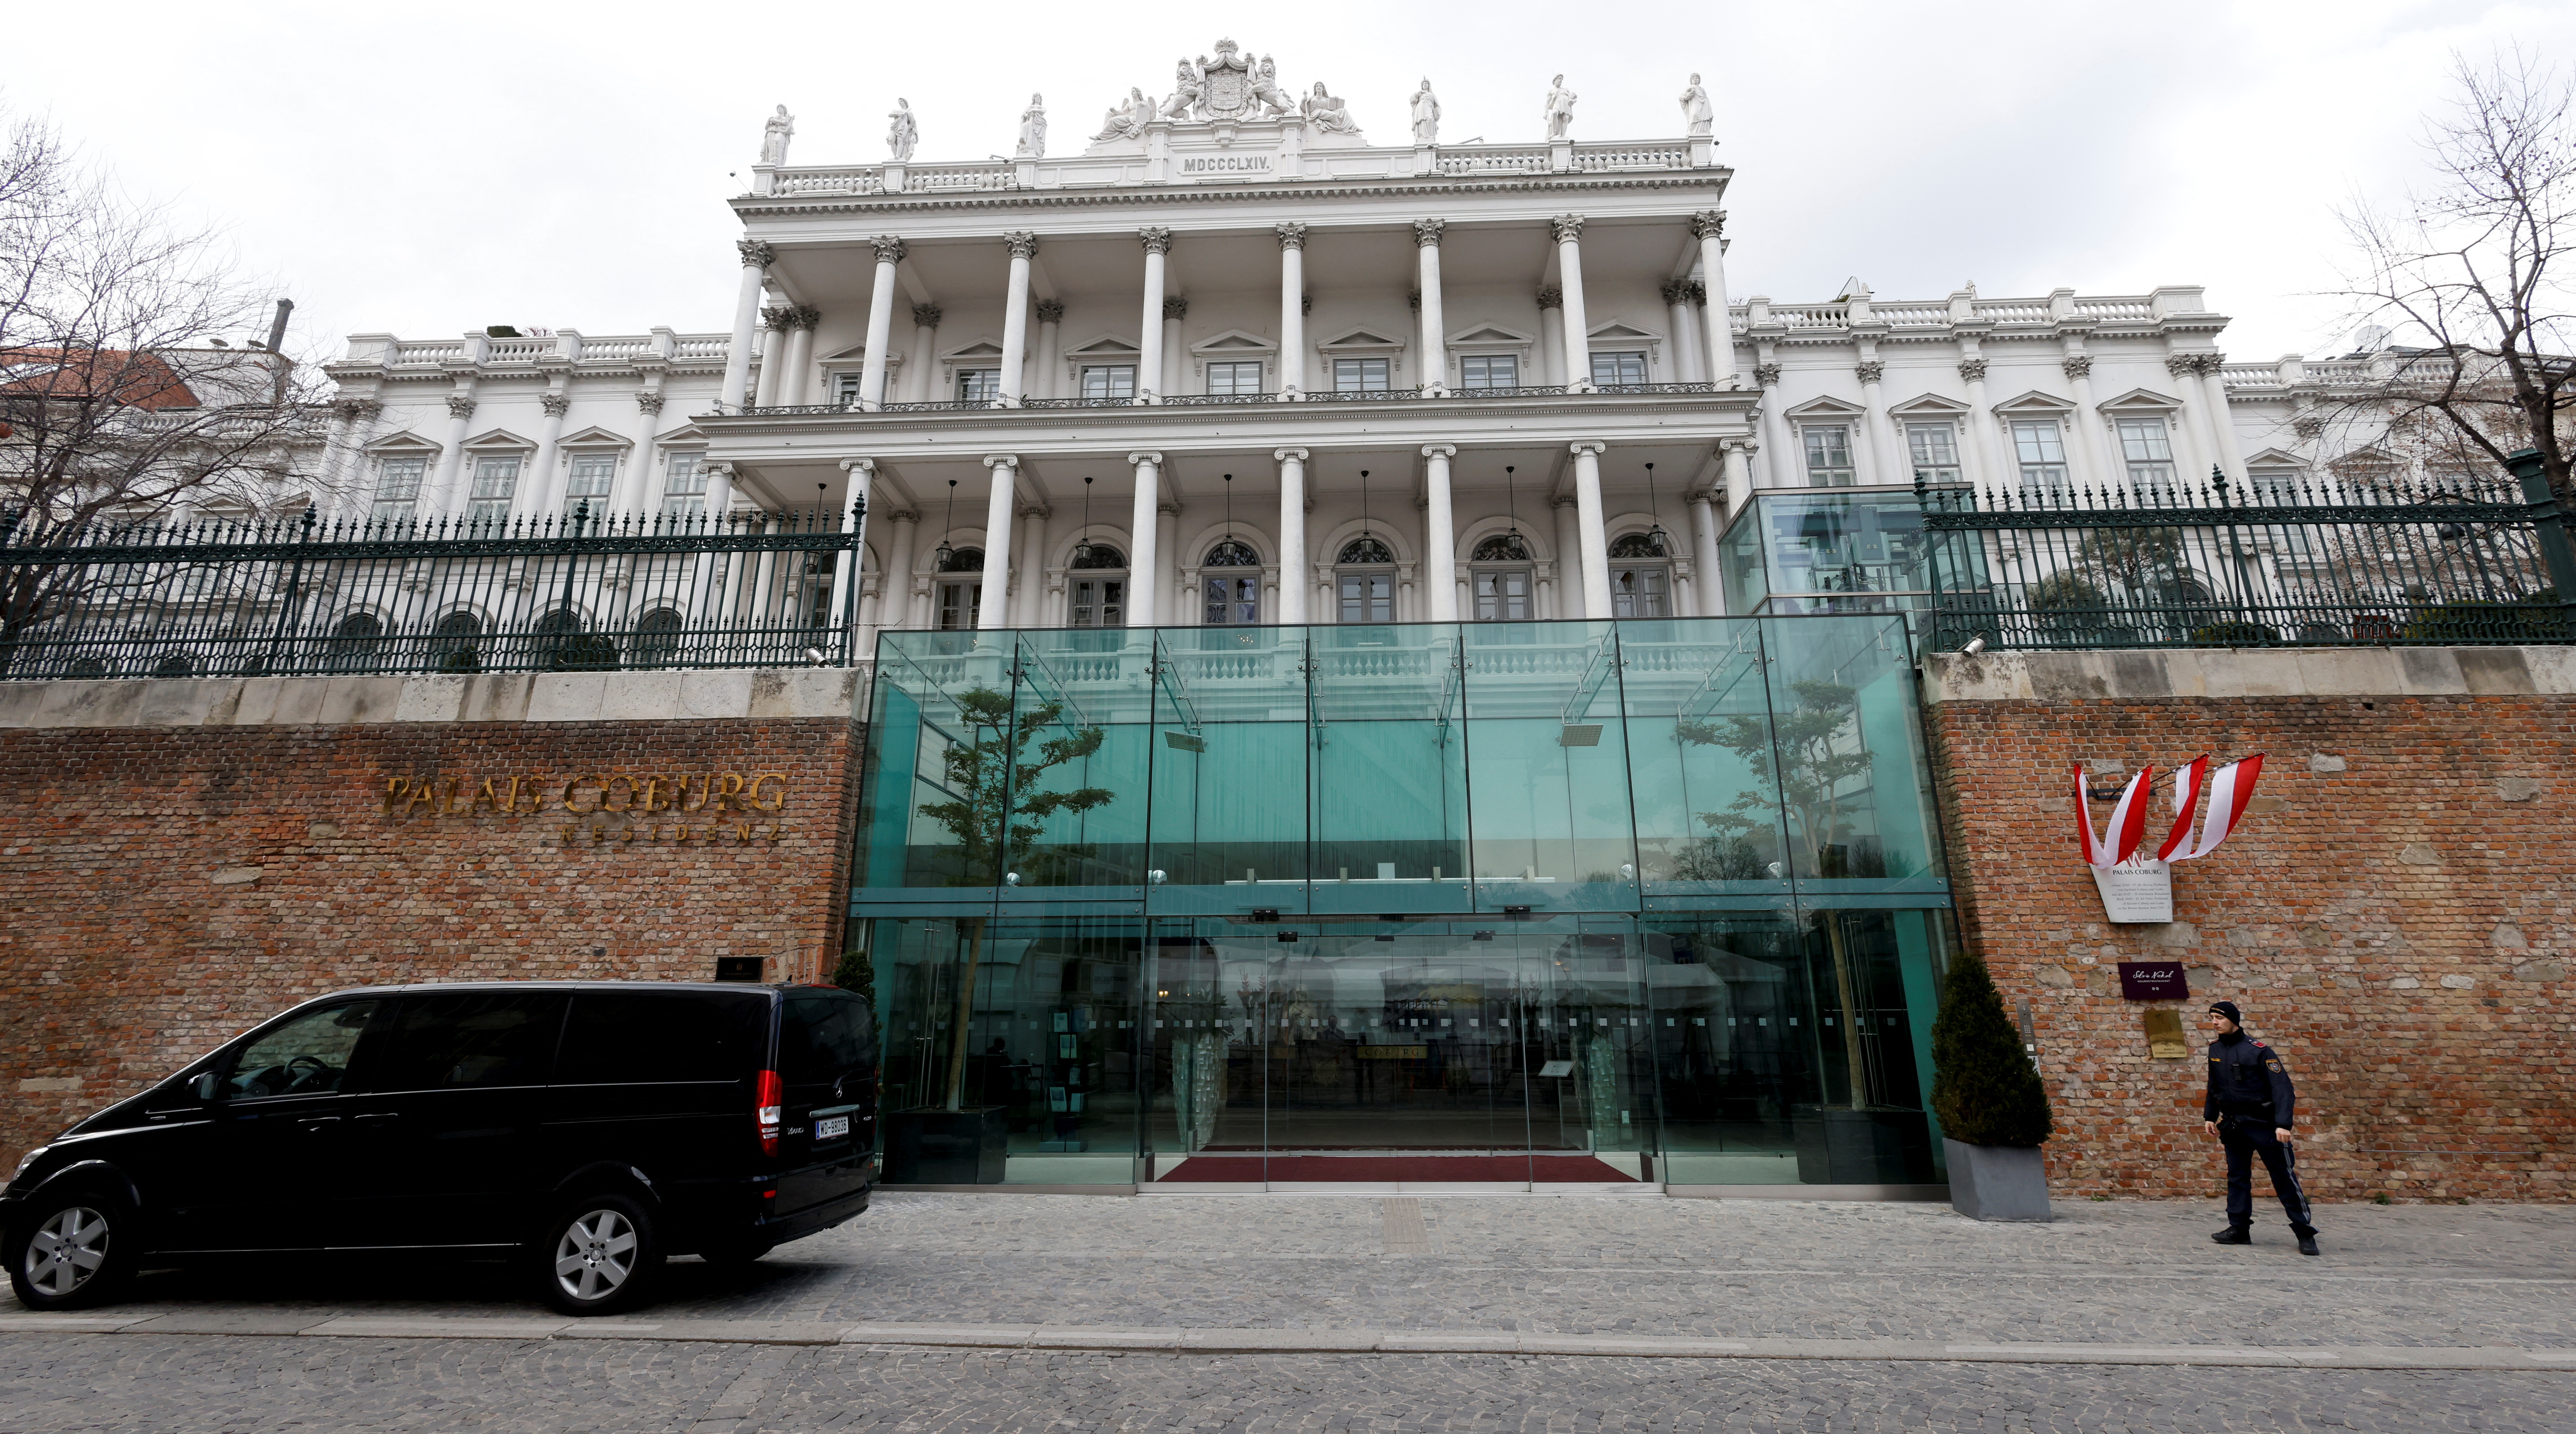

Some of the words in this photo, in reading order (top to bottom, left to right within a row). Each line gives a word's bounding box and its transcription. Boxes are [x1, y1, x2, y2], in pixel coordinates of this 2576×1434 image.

[1184, 156, 1270, 171] MDCCCLXIV.
[380, 776, 546, 814] PALAIS
[564, 773, 786, 812] COBURG
[561, 824, 780, 841] RESIDENZ
[2133, 970, 2150, 978] Silvio
[2151, 970, 2174, 979] Nickol
[1365, 1048, 1420, 1056] COBURG
[820, 1119, 847, 1136] WD-98036
